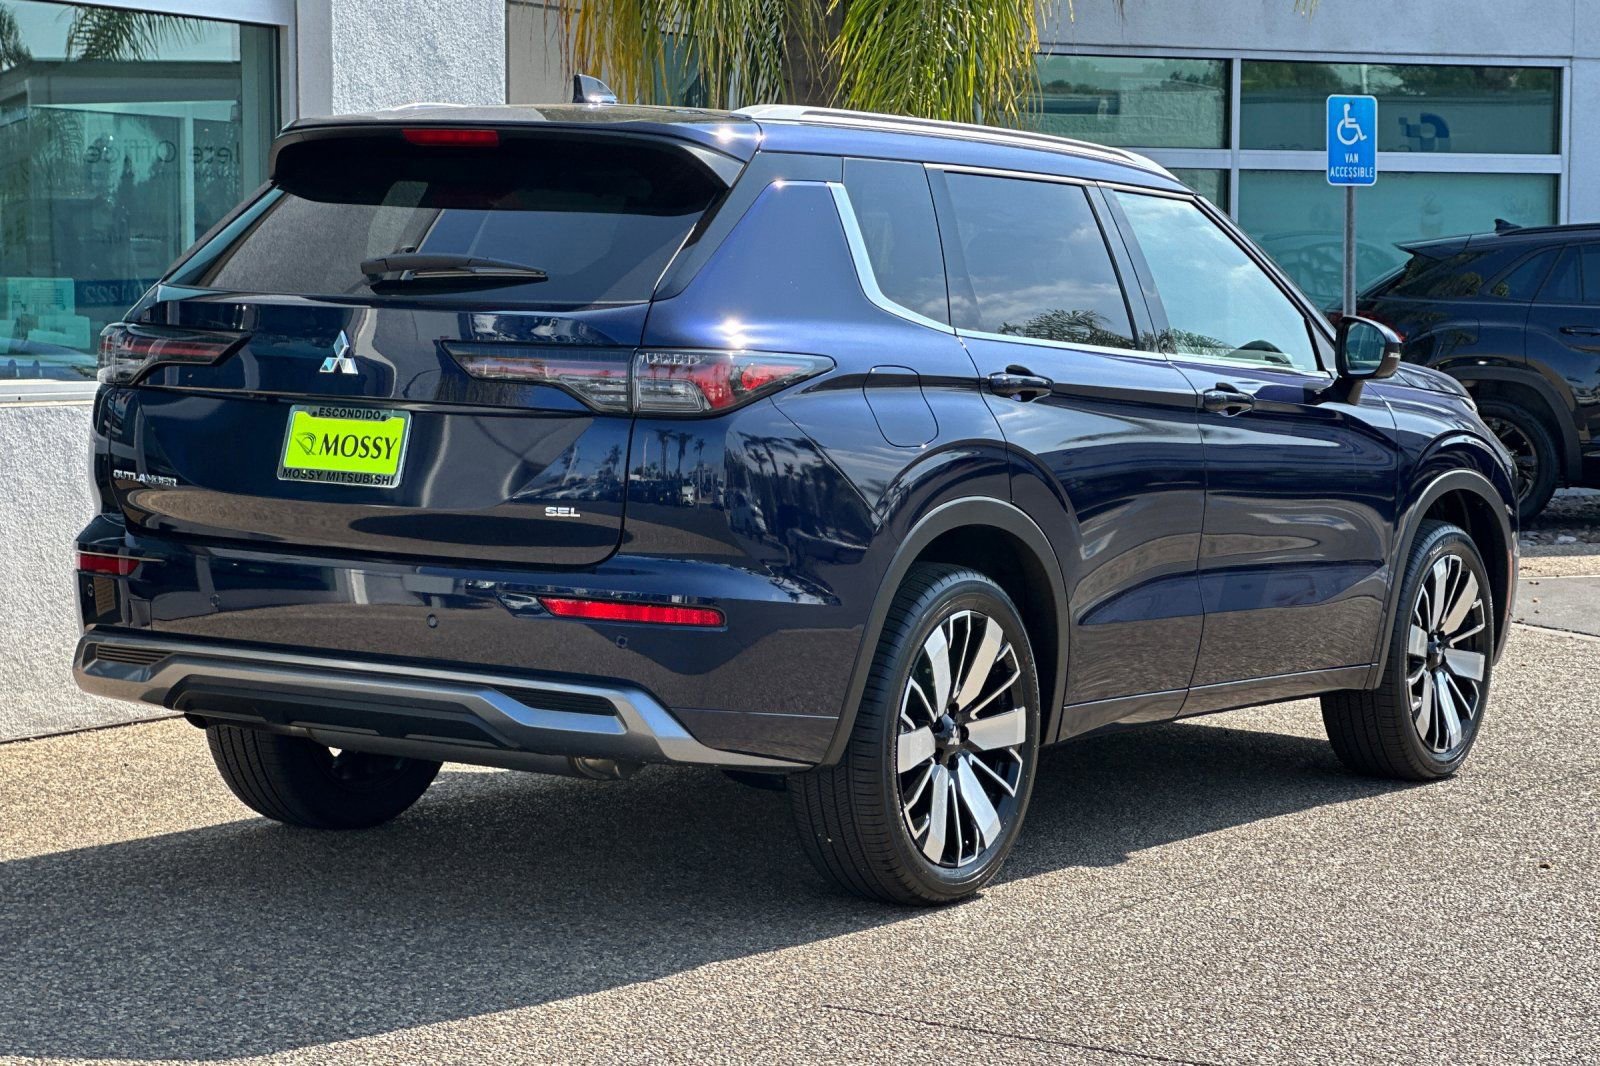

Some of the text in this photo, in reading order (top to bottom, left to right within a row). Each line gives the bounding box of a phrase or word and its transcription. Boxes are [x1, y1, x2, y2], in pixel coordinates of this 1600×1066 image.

[1344, 152, 1359, 164] VAN
[1330, 166, 1374, 178] ACCESSIBLE
[318, 407, 381, 420] ESCONDIDO
[319, 433, 398, 460] MOSSY
[282, 468, 394, 486] MOSSY MITSUBISHI
[545, 506, 580, 518] SEL
